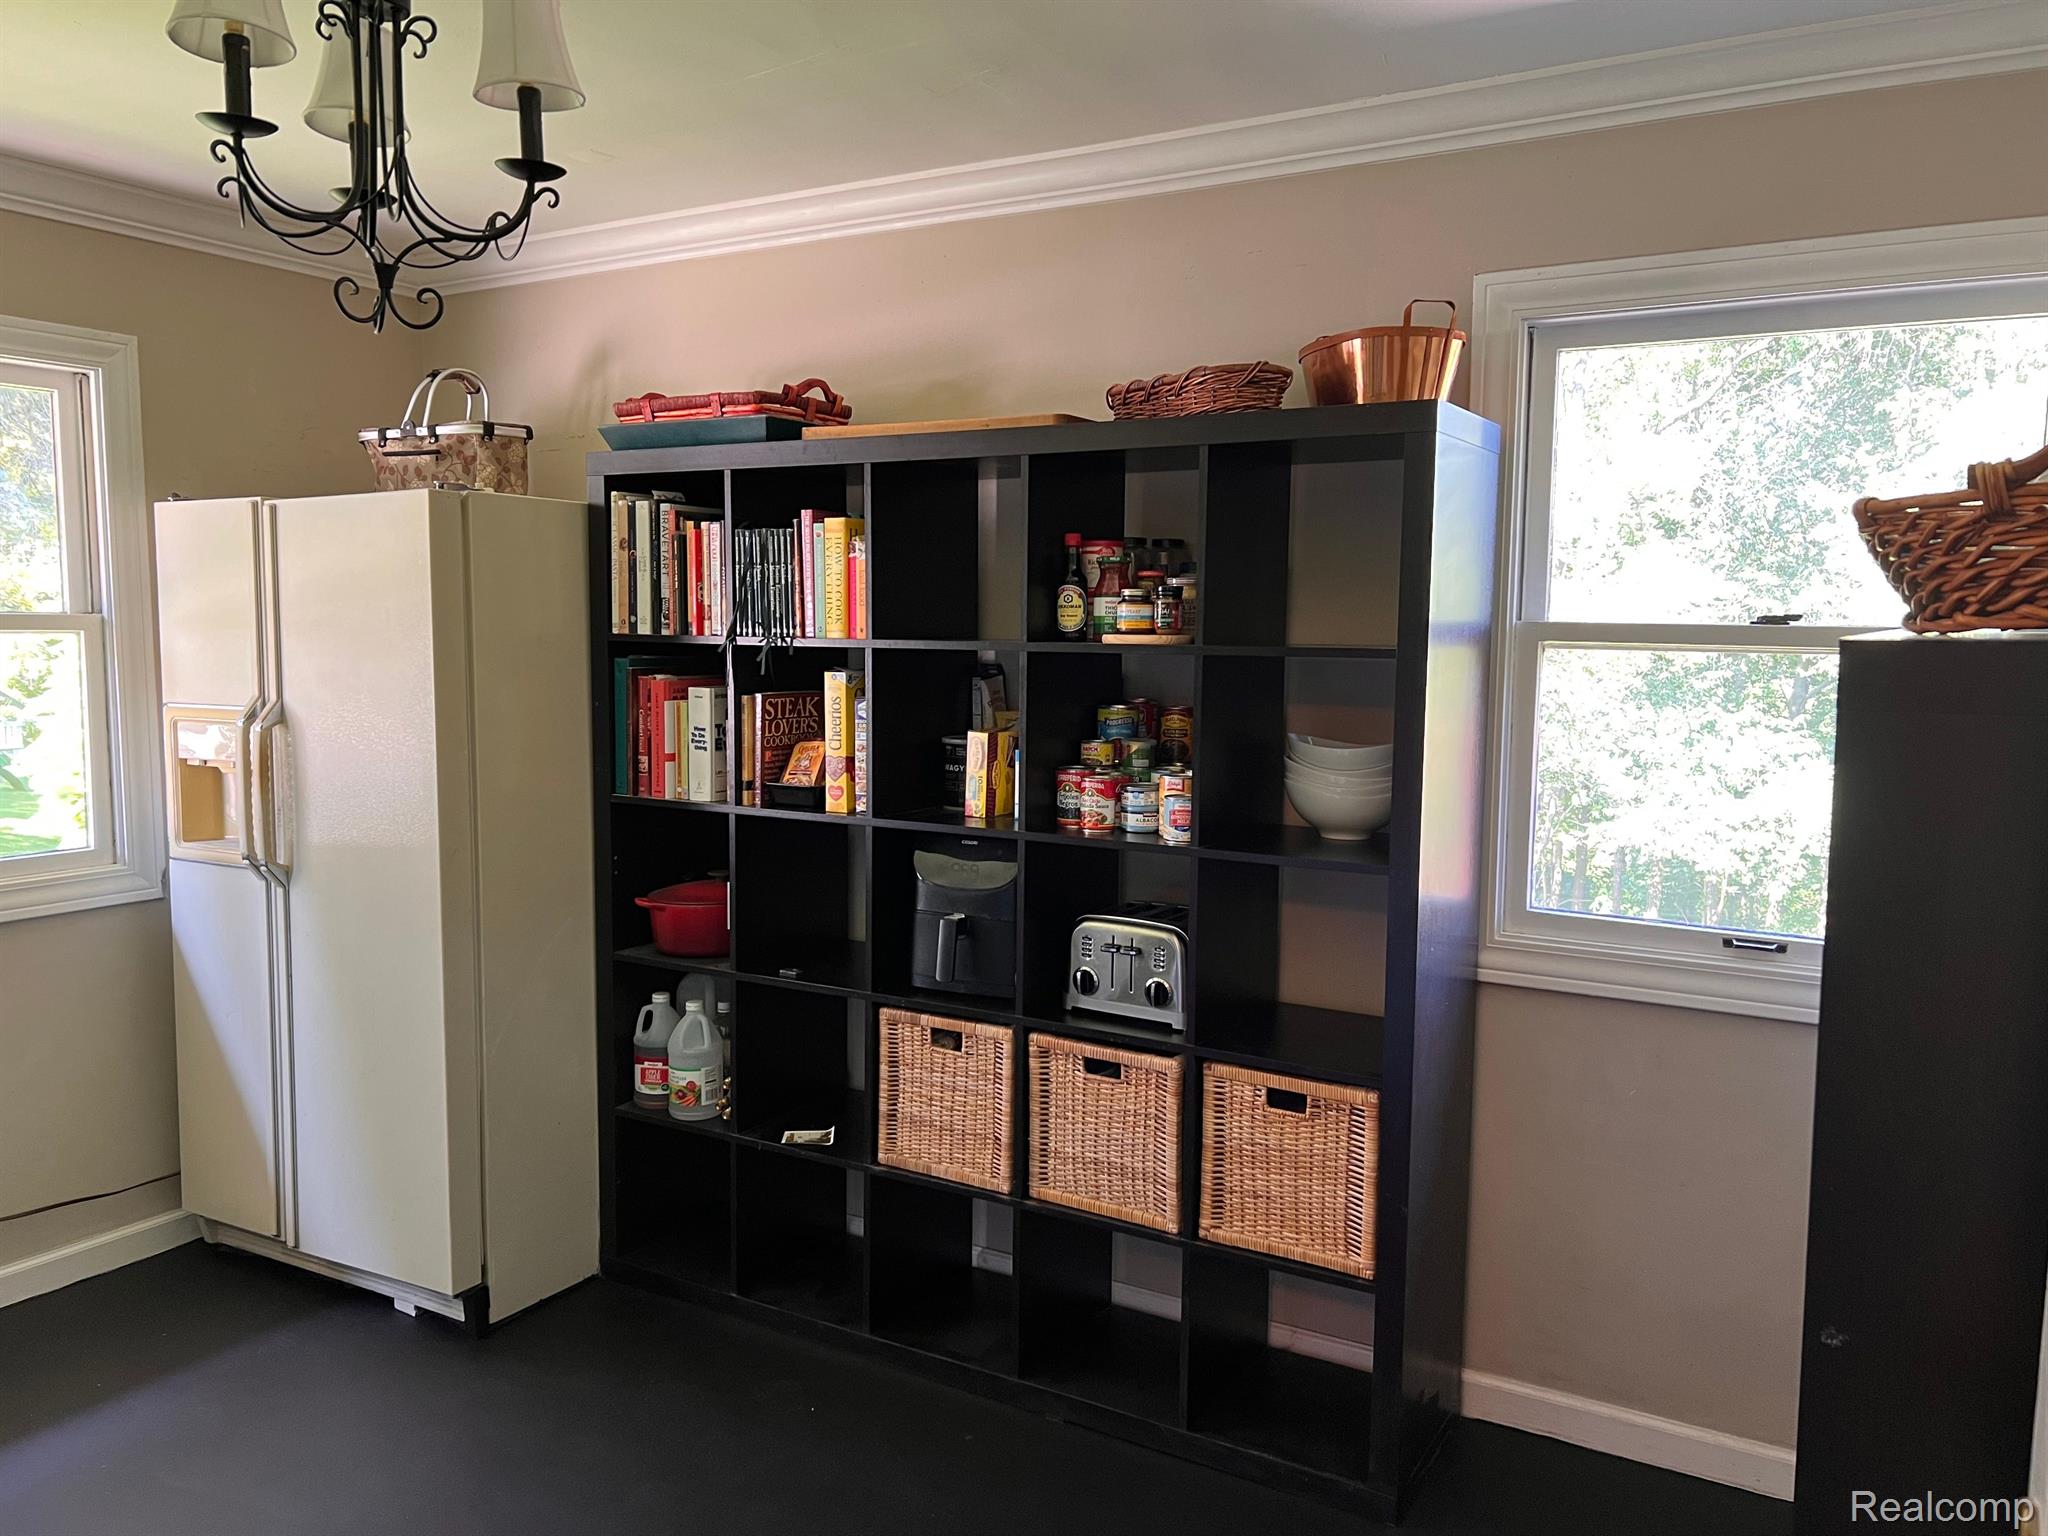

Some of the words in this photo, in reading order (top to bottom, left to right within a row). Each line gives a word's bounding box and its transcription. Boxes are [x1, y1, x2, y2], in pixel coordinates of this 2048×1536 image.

[661, 510, 669, 576] BRAVETART
[835, 568, 842, 586] TO
[835, 588, 843, 625] COOK
[764, 696, 820, 720] STEAK
[764, 717, 818, 737] LOVER'S
[829, 696, 842, 751] Cheerios
